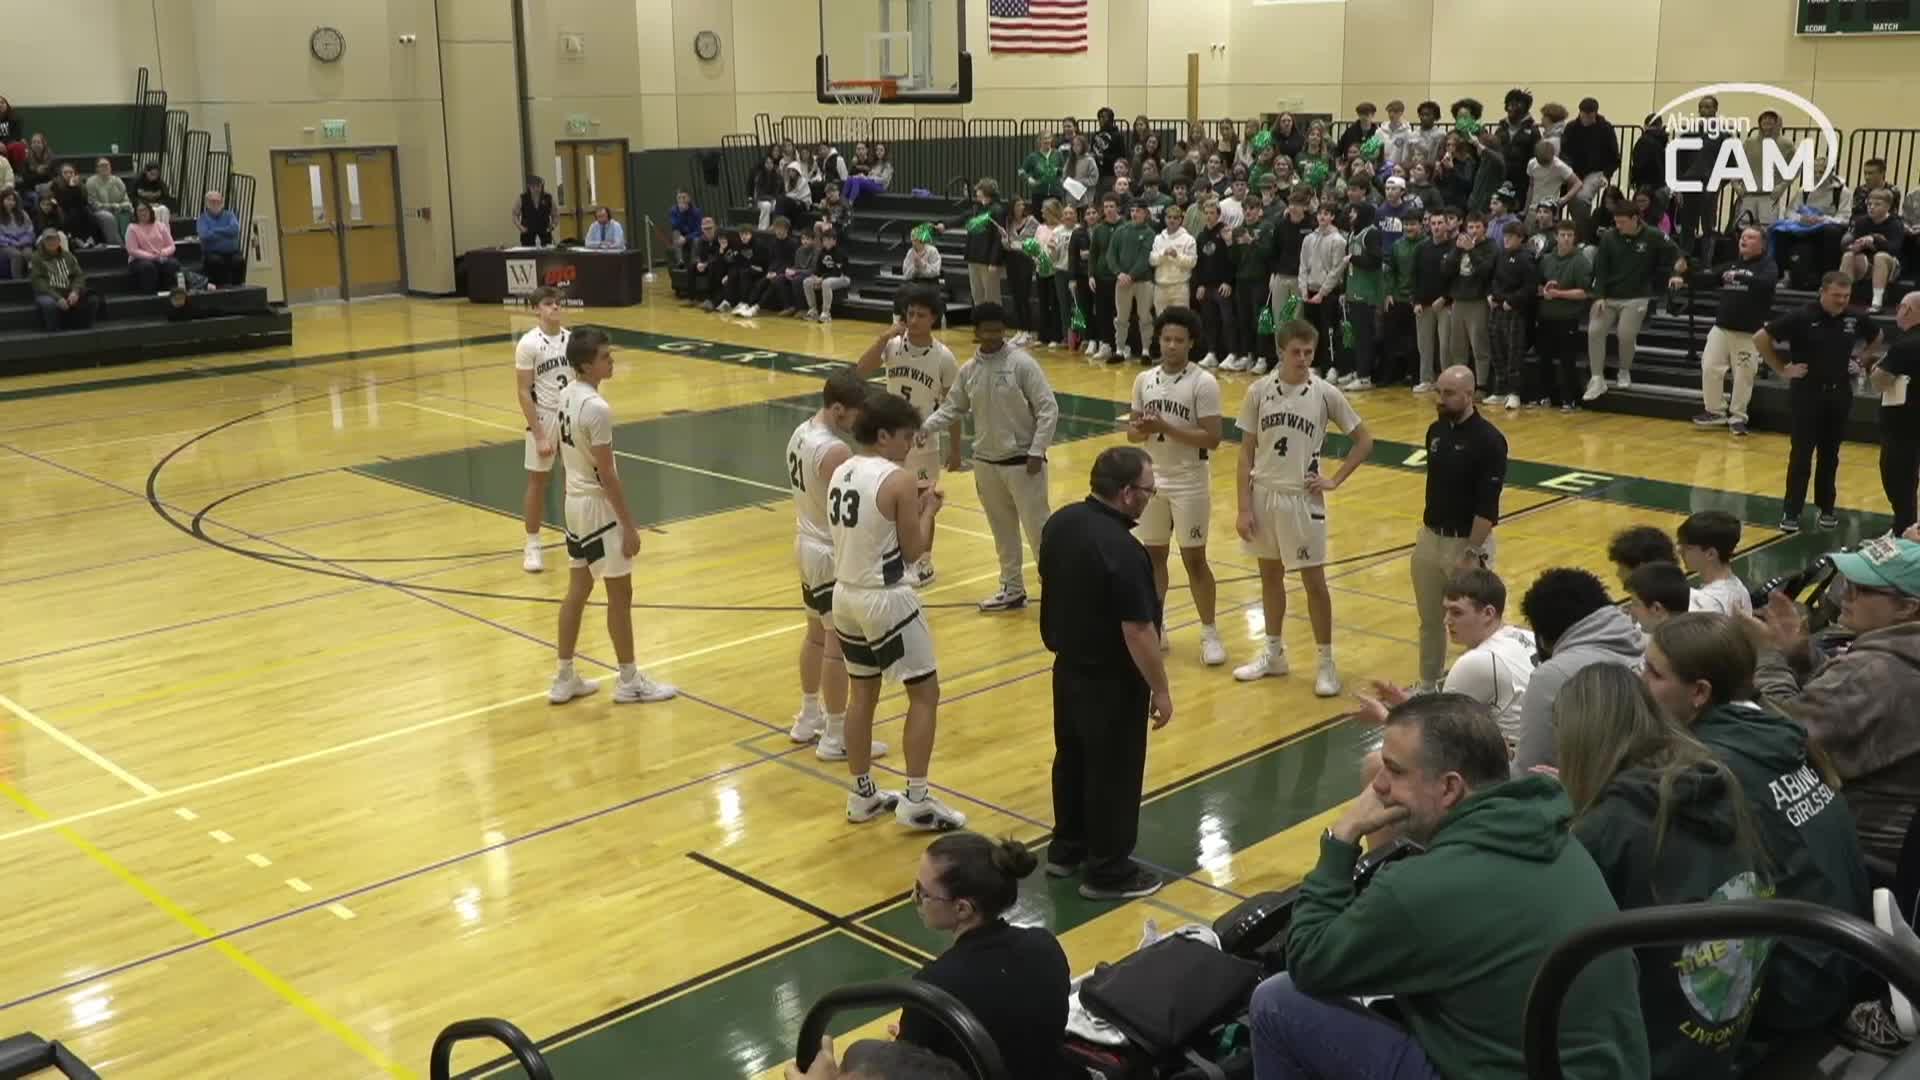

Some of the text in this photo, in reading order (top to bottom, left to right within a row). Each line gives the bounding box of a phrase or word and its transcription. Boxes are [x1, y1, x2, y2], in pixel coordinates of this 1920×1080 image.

[1803, 23, 1899, 33] SCORE MATCH
[509, 264, 534, 285] W
[556, 374, 569, 390] 3
[900, 384, 913, 402] 5
[1163, 399, 1191, 422] WAVE
[1260, 412, 1315, 439] GREEN WAVE
[1274, 436, 1289, 457] 4
[789, 451, 807, 493] 21
[828, 487, 861, 528] 33
[1785, 791, 1825, 827] GIRLS
